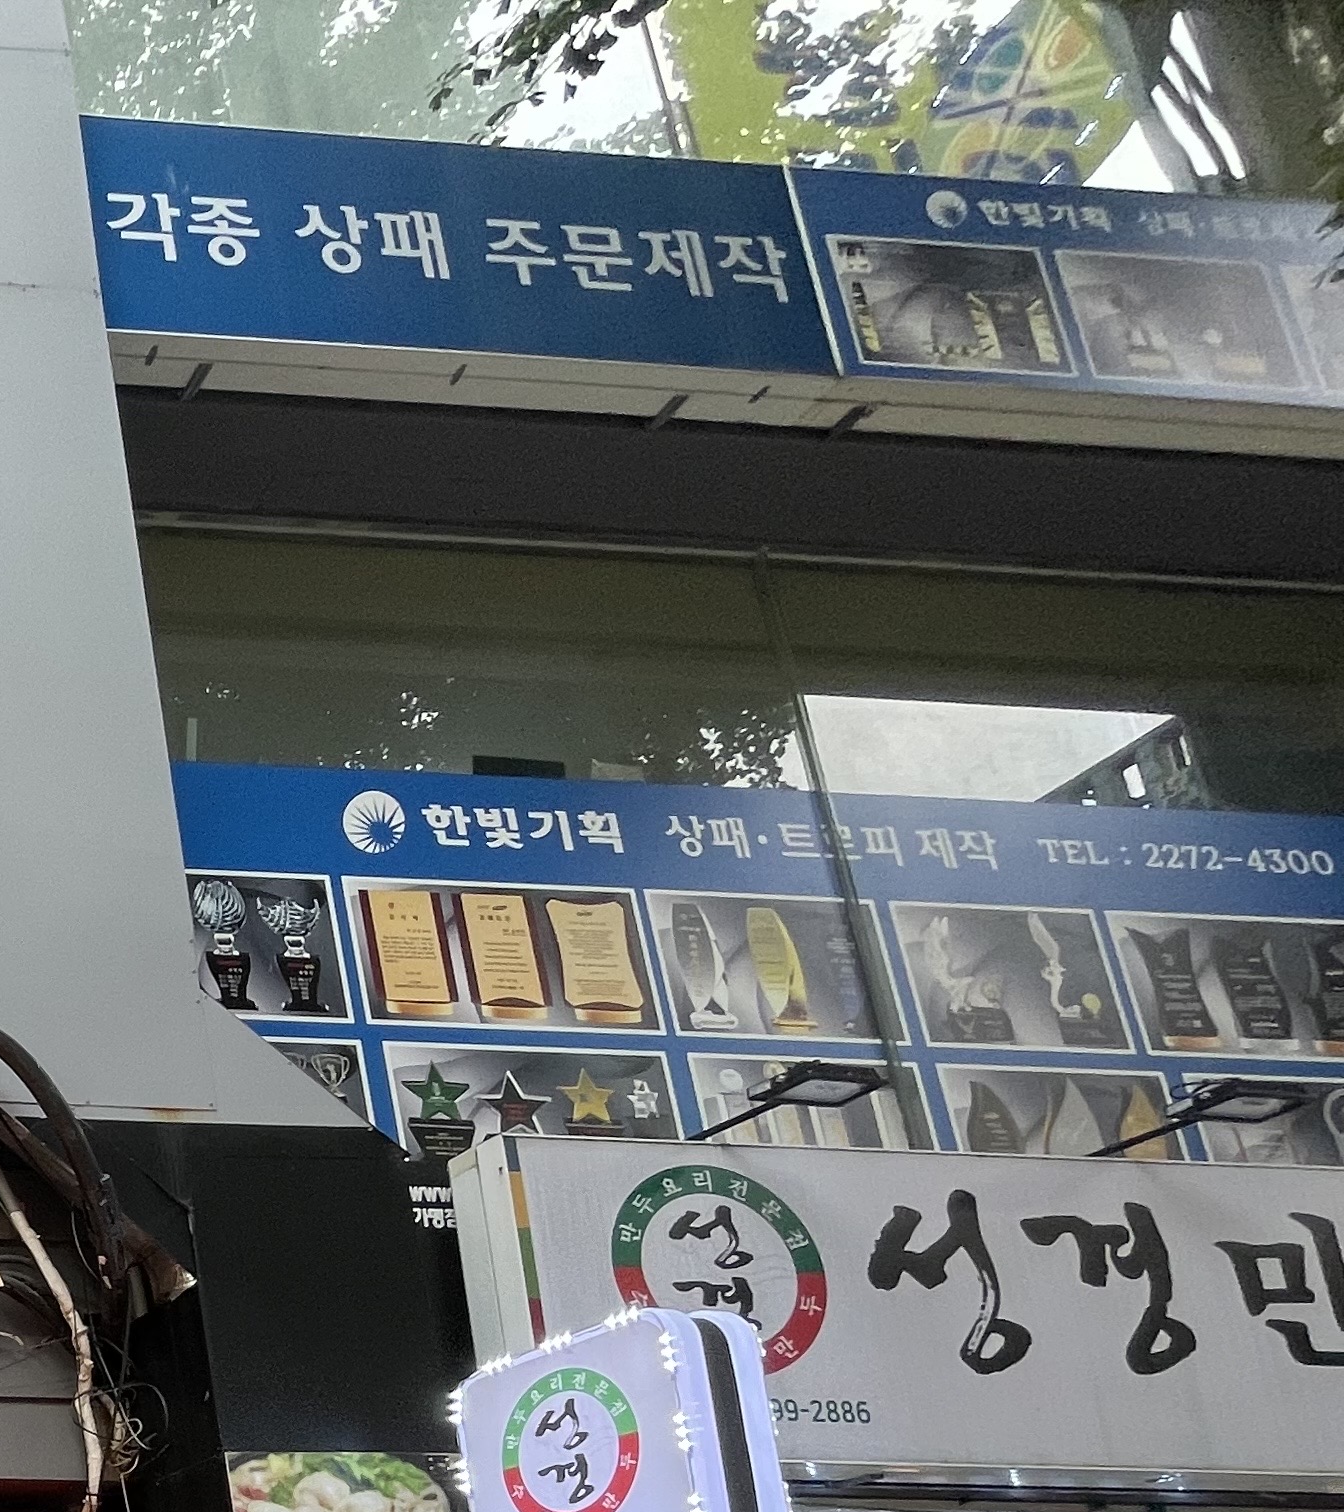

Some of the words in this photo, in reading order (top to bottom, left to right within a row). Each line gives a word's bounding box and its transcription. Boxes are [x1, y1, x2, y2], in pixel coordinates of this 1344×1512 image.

[105, 191, 261, 268] 각종
[293, 203, 451, 281] 상패
[485, 218, 789, 304] 주문제작
[423, 801, 624, 856] 한빛기획
[664, 814, 904, 868] 상패·트로피
[915, 827, 998, 870] 제작
[1036, 836, 1111, 868] TEL
[1141, 842, 1335, 878] 2272-4300
[535, 1398, 595, 1504] 성경
